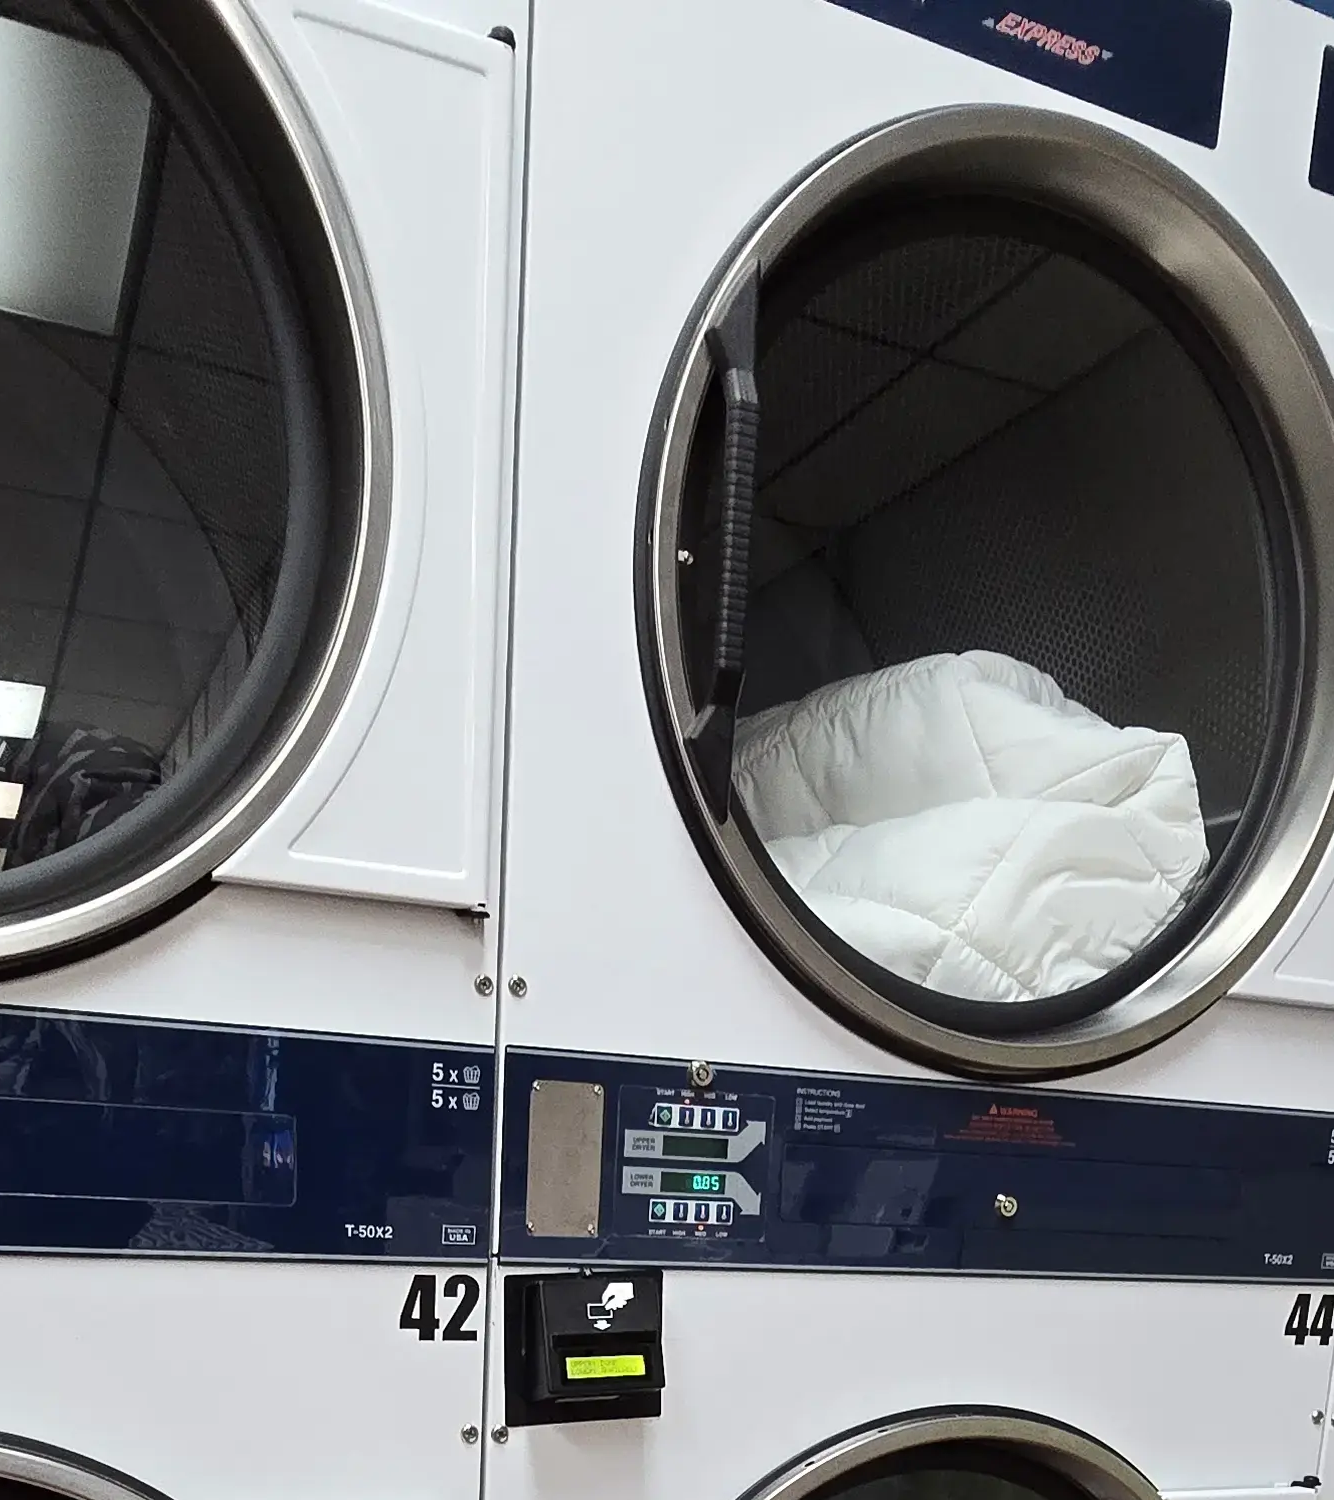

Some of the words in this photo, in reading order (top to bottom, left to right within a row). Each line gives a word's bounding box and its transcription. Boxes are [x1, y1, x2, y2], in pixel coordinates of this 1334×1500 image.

[996, 12, 1101, 66] EXPRESS
[431, 1063, 444, 1082] 5
[448, 1070, 459, 1083] x
[431, 1089, 443, 1109] 5
[447, 1096, 458, 1110] x
[345, 1224, 393, 1239] T-50X2
[1264, 1253, 1294, 1265] T-50X2
[399, 1274, 480, 1341] 42
